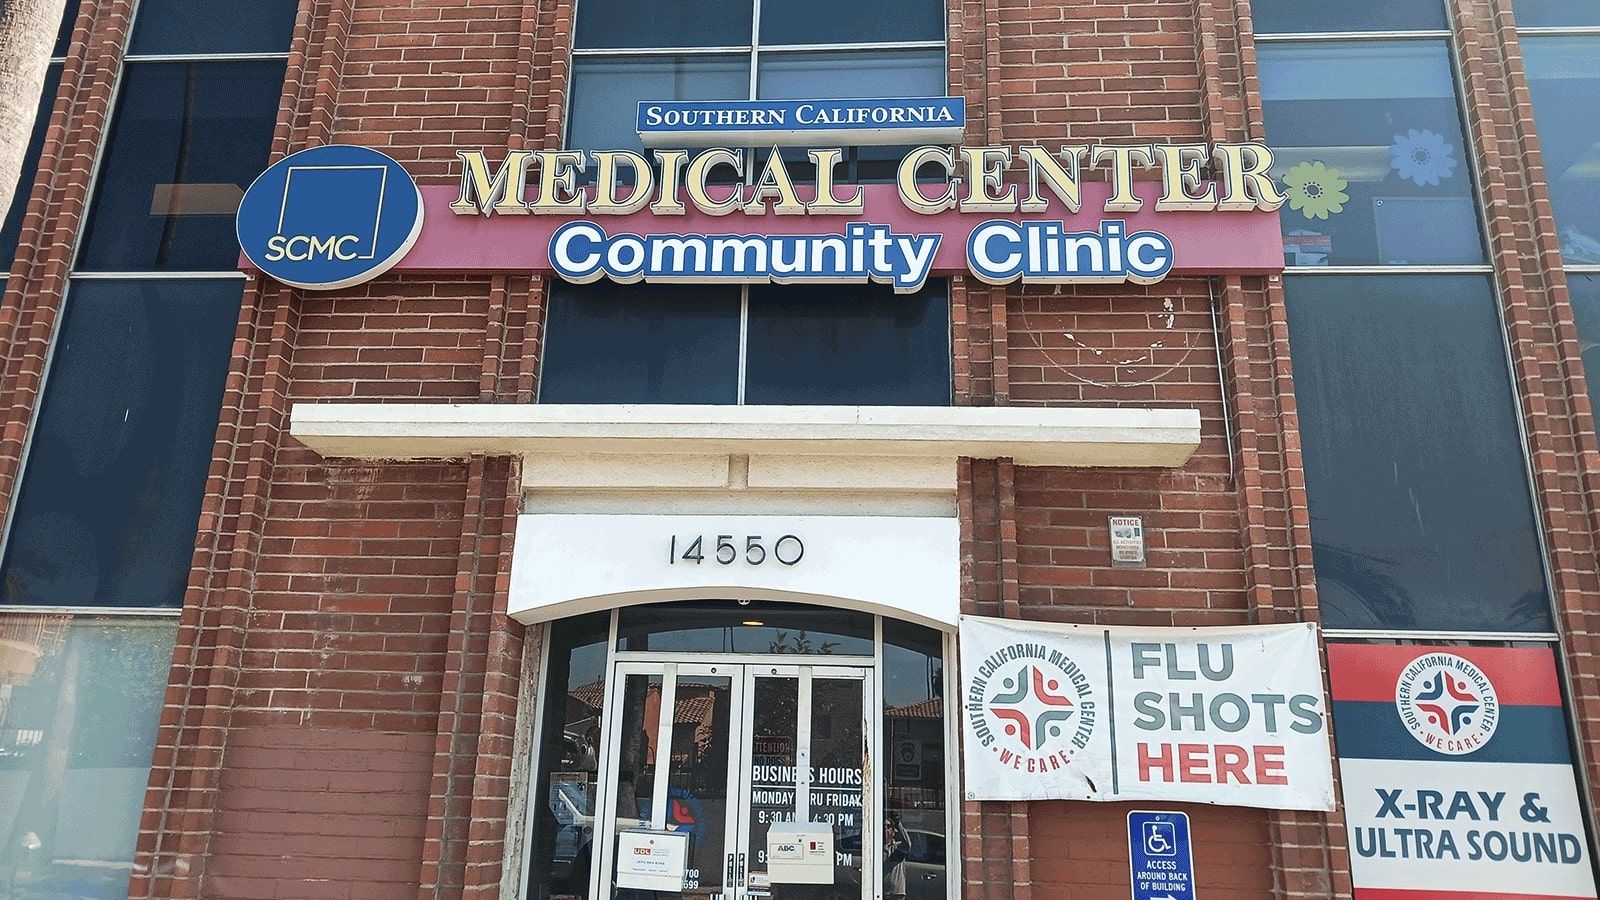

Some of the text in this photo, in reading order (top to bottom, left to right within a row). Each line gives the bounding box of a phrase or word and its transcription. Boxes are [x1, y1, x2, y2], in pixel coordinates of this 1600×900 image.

[646, 104, 955, 126] SOUTHERN CALIFORNIA
[449, 142, 1288, 217] MEDICAL CENTER
[264, 234, 360, 262] SCMC
[551, 222, 1171, 286] Community Clinic
[669, 534, 804, 566] 14550
[1131, 642, 1234, 681] FLU
[968, 643, 1095, 750] SOUTHERN CALIFORNIA MEDICAL CENTER
[1399, 655, 1495, 733] SOUTHERN CALIFORNIA MEDICAL CENTER
[1133, 691, 1323, 734] SHOTS
[1425, 733, 1480, 752] WE CARE
[999, 747, 1070, 773] WE CARE
[1137, 742, 1289, 785] HERE
[752, 765, 862, 785] BUSINES HOURS
[752, 791, 794, 805] MONDAY
[810, 792, 823, 806] RU
[1374, 788, 1552, 823] X-RAY &
[838, 813, 854, 827] PM
[836, 852, 852, 867] PM
[1354, 826, 1582, 865] ULTRA SOUND
[1136, 871, 1188, 881] AROUND BACK
[1146, 860, 1177, 870] ACCESS
[1140, 882, 1186, 891] OF BUILDING
